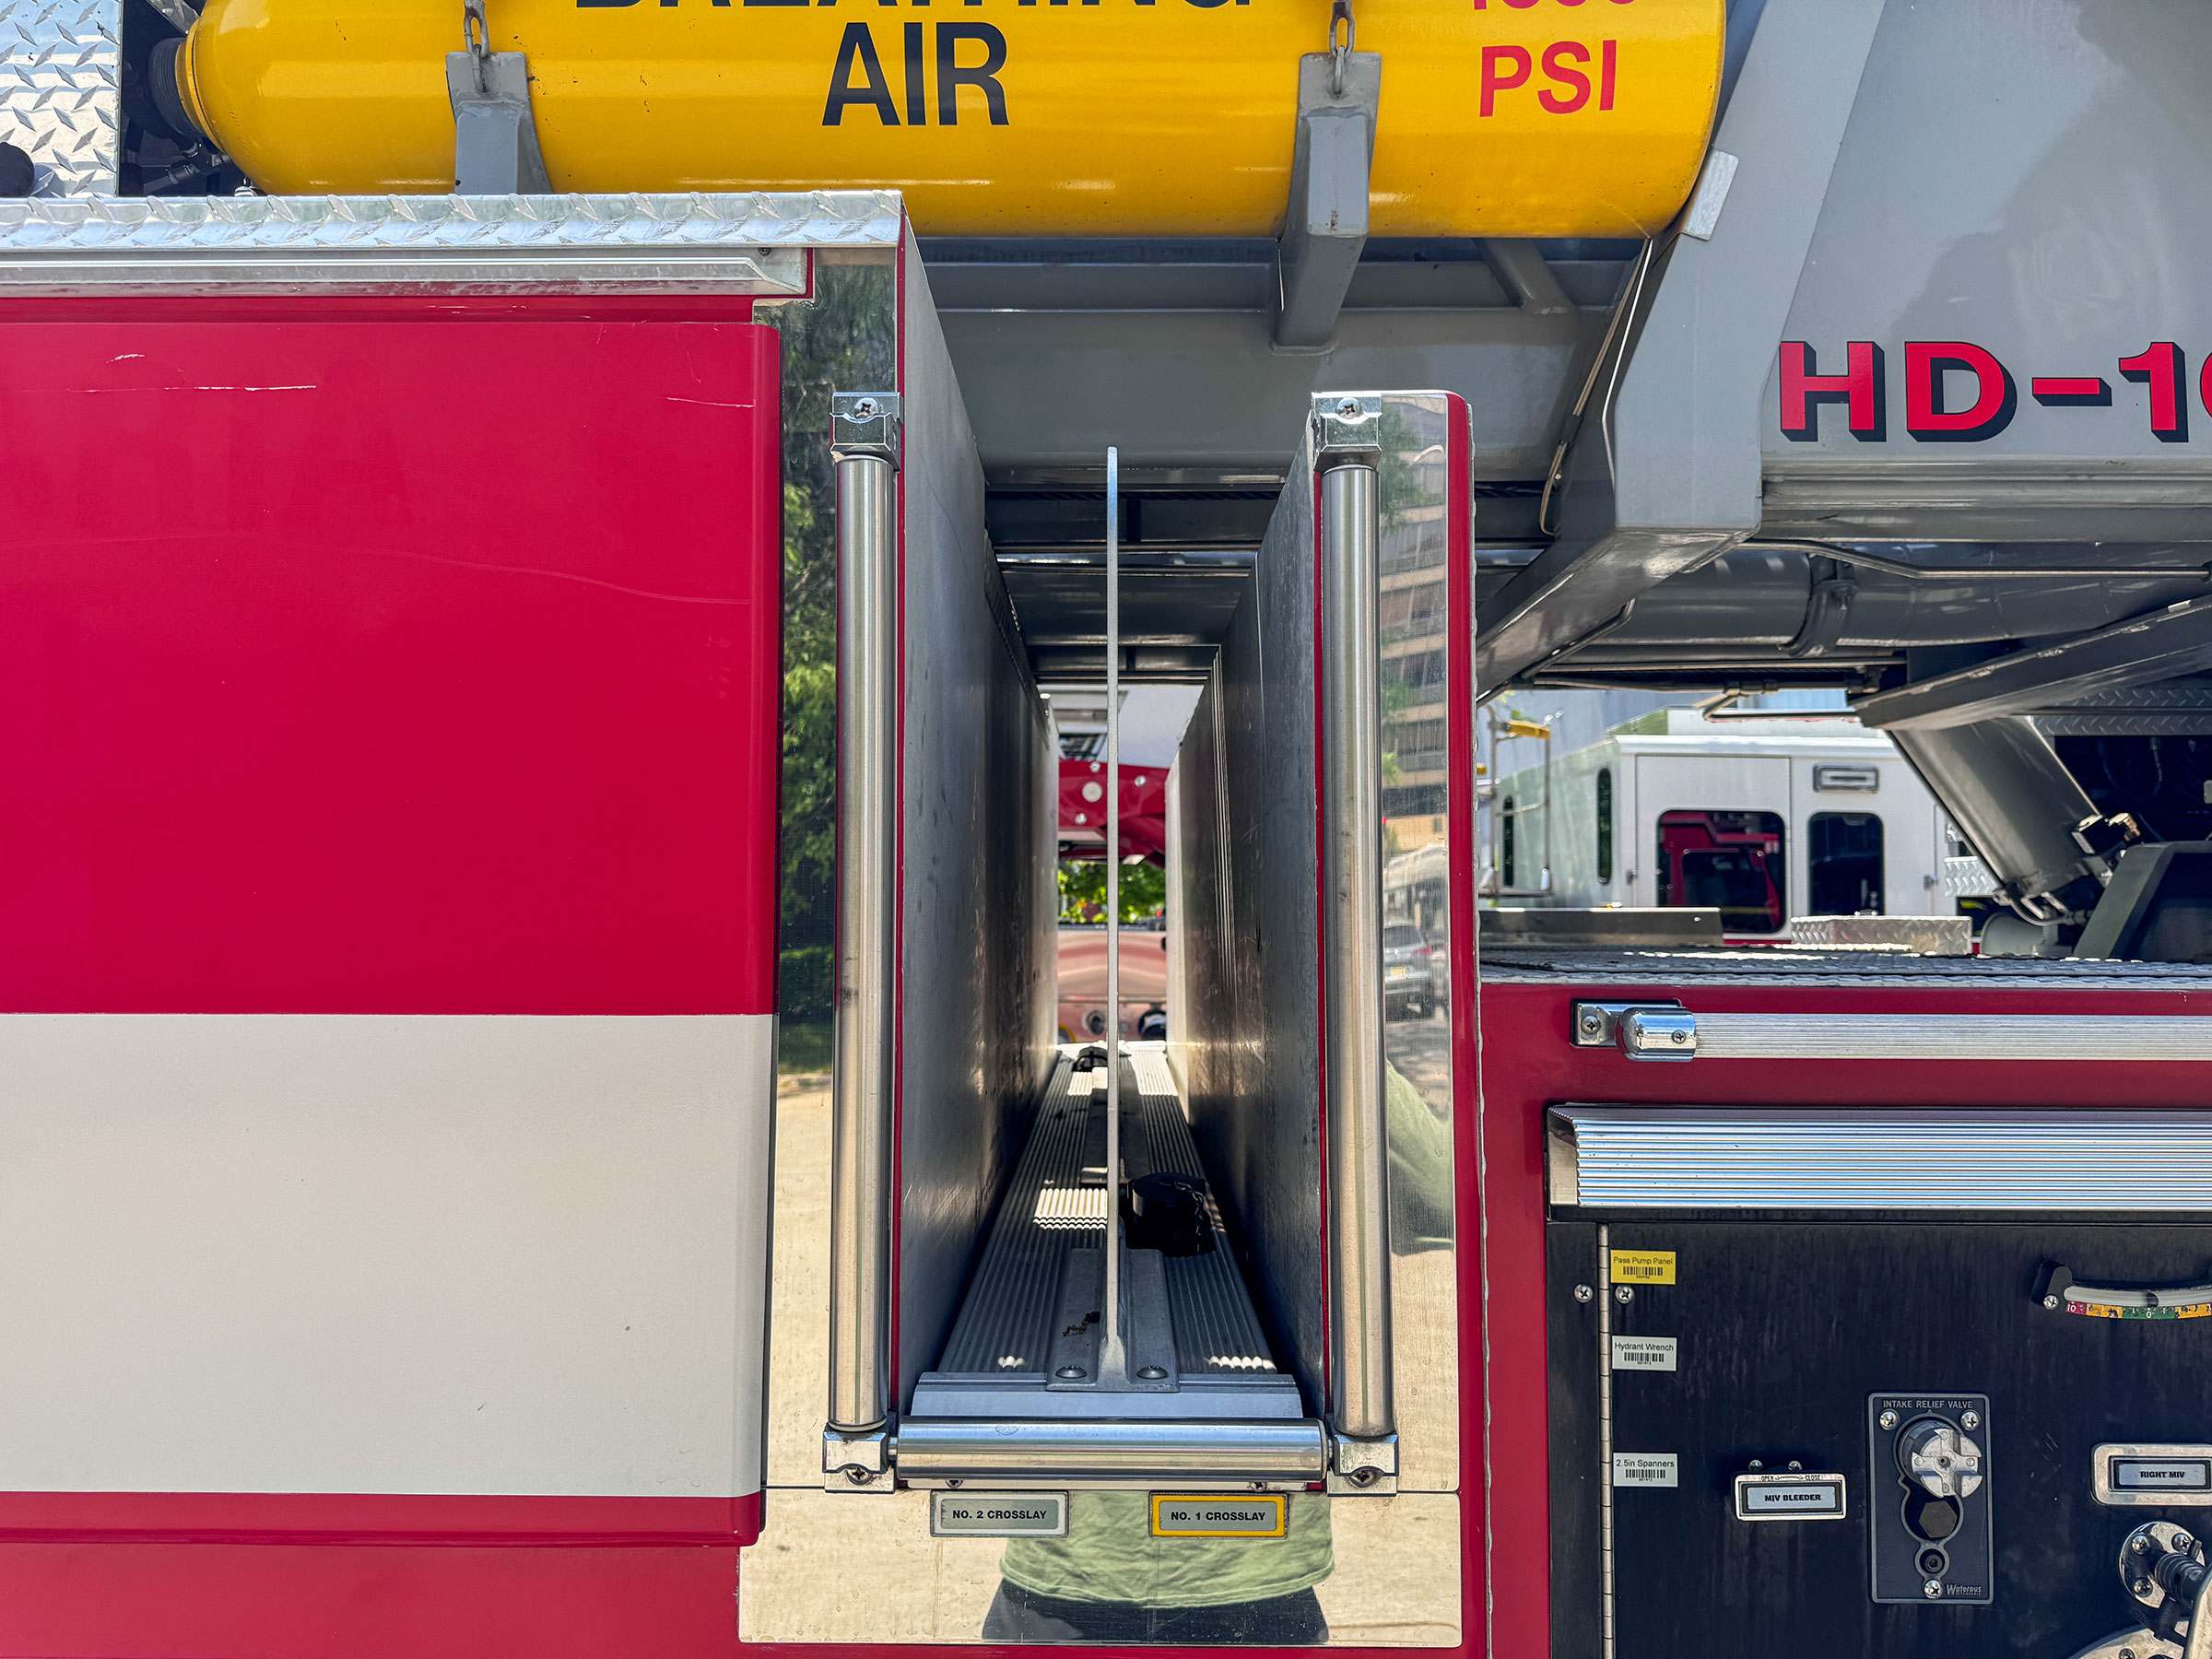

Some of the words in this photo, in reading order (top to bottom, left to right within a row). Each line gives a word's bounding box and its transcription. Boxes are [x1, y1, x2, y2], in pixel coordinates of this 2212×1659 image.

[821, 22, 1010, 126] AIR
[1479, 39, 1617, 117] PSI
[1779, 340, 2212, 442] HD-1
[1632, 1257, 1652, 1265] Pump
[2066, 1304, 2077, 1312] 10
[1615, 1343, 1644, 1351] Hydrant
[1883, 1400, 1912, 1408] INTAKE
[1916, 1400, 1945, 1408] RELIEF
[1947, 1400, 1973, 1409] VALVE
[1616, 1459, 1636, 1467] 2.5in
[1637, 1459, 1675, 1468] Spanners
[952, 1510, 972, 1519] NO.
[976, 1510, 983, 1519] 2
[987, 1510, 1047, 1519] CROSSLAY
[1171, 1512, 1192, 1521] NO.
[1195, 1512, 1201, 1521] 1
[1206, 1512, 1265, 1521] CROSSLAY
[1946, 1583, 1982, 1595] Waterous
